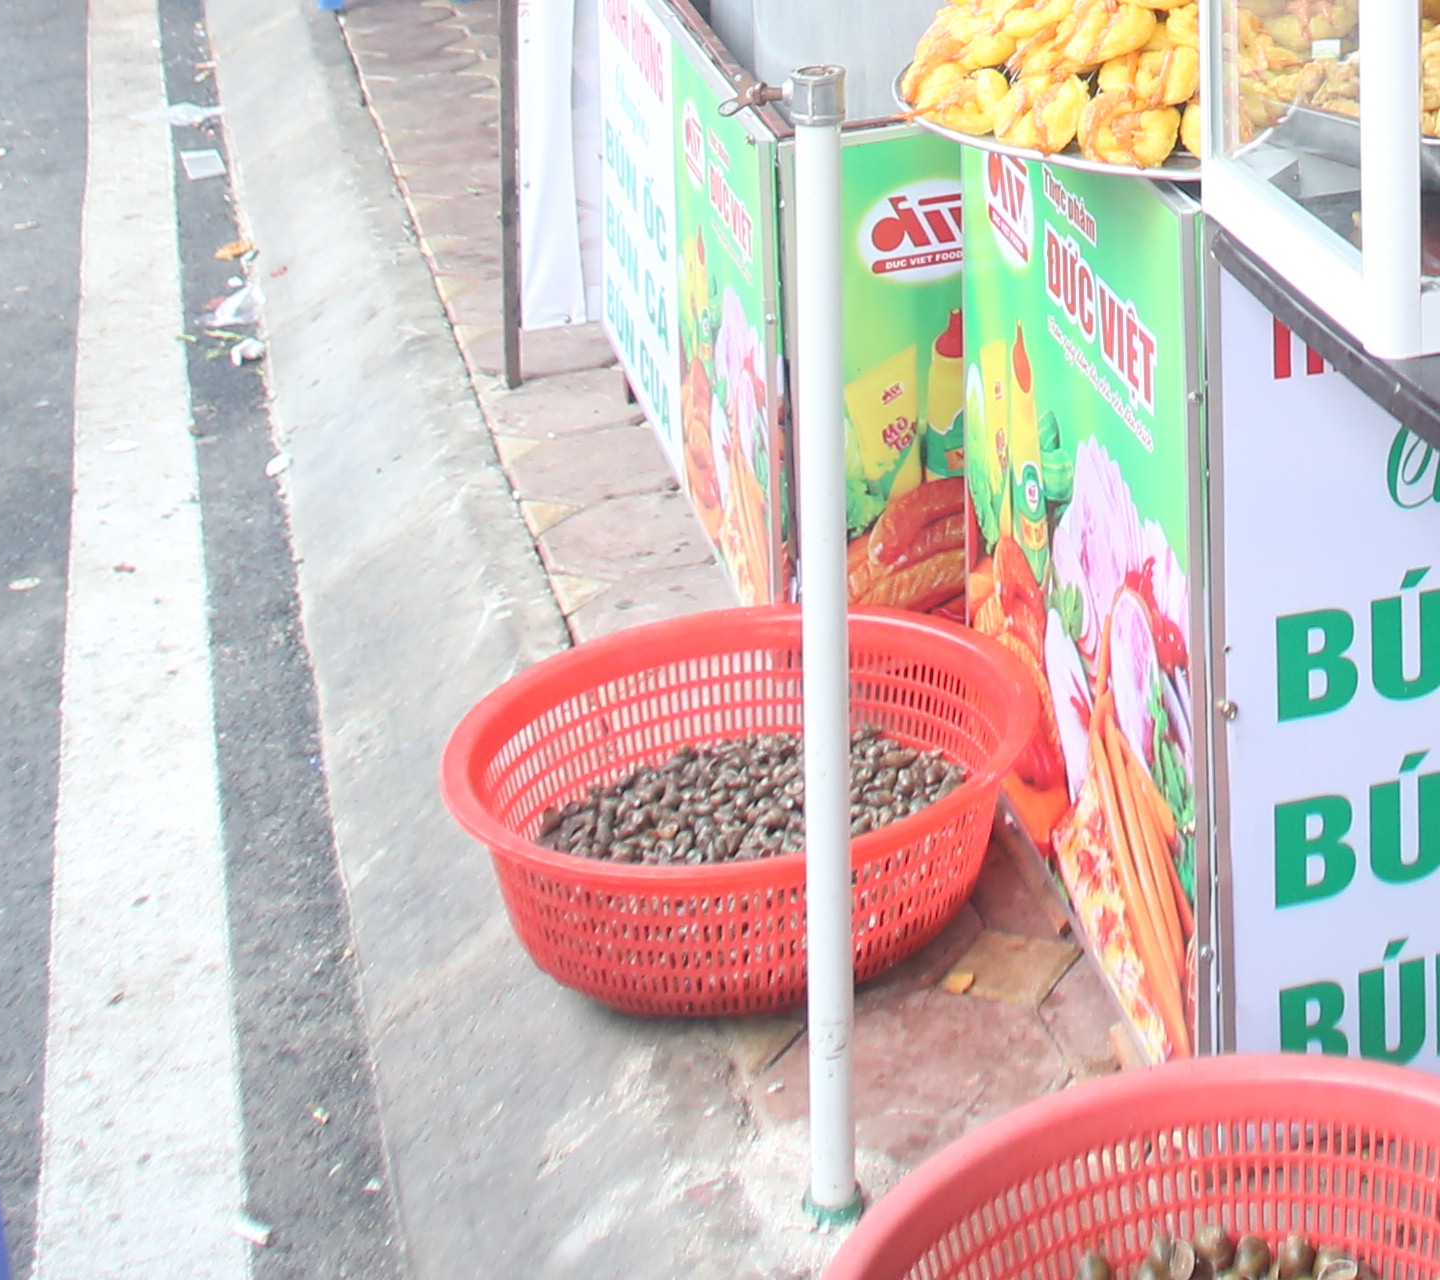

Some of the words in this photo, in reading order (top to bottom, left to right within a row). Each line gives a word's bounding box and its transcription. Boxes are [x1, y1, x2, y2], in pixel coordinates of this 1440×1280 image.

[909, 253, 934, 266] VIET
[935, 249, 964, 262] FOOD
[1045, 226, 1094, 338] ĐỨC
[1097, 280, 1155, 410] VIỆT
